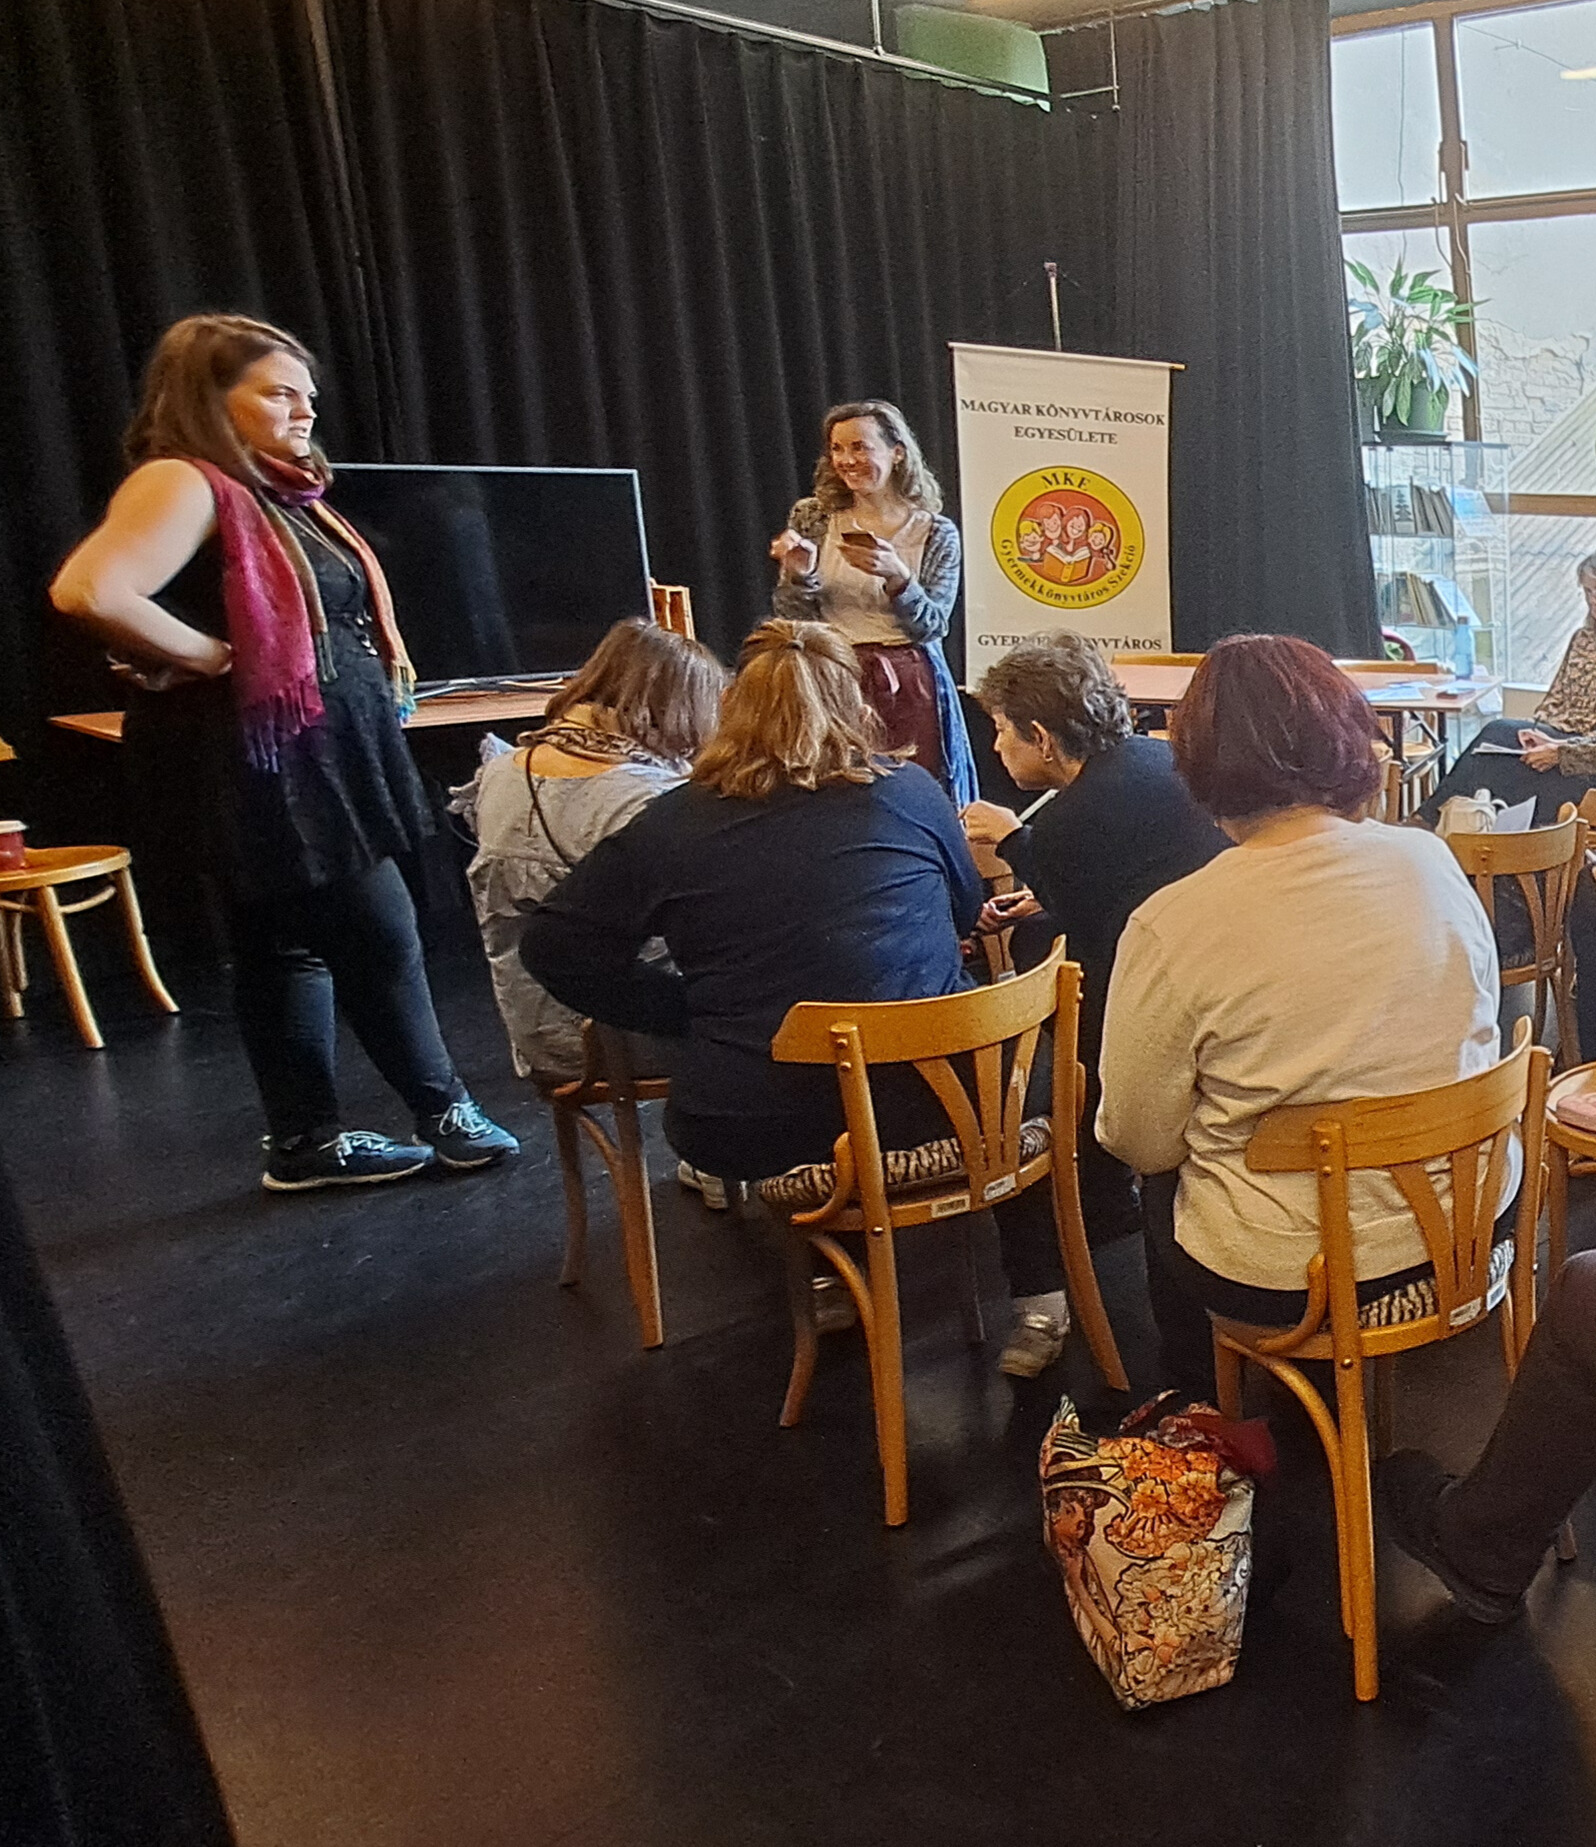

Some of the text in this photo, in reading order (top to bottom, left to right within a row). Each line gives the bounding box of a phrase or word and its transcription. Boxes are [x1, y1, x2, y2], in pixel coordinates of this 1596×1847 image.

[960, 398, 1166, 426] MAGYAR KÖNYVTÁROSOK
[1013, 425, 1118, 445] EGYESÜLETE
[1041, 472, 1091, 491] MKE
[1001, 539, 1136, 604] Gyermekkönyvtáros Szekció
[977, 634, 1162, 650] GYEREYVTÁROS
